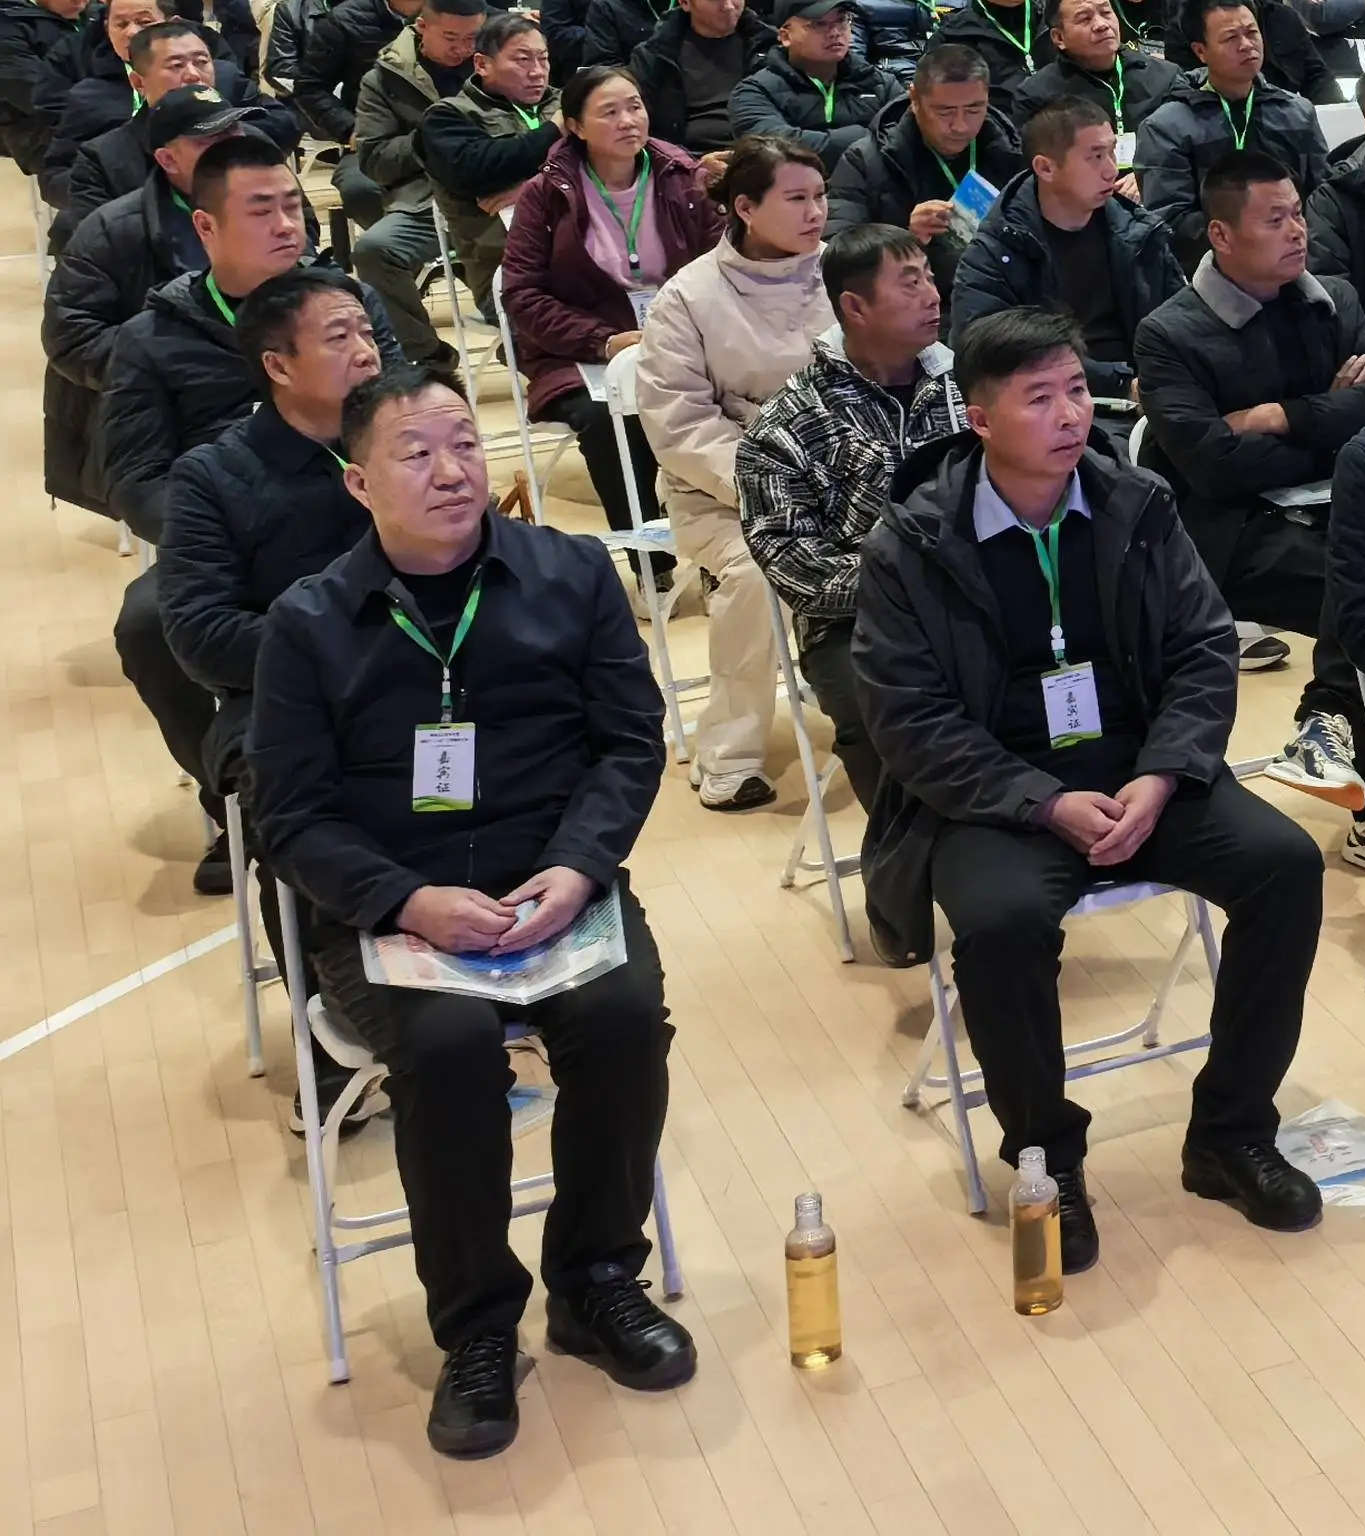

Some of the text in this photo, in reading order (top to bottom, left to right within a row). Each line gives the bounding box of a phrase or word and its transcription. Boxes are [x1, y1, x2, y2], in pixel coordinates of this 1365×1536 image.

[1066, 690, 1081, 730] 嘉宾证
[437, 750, 452, 794] 嘉宾证
